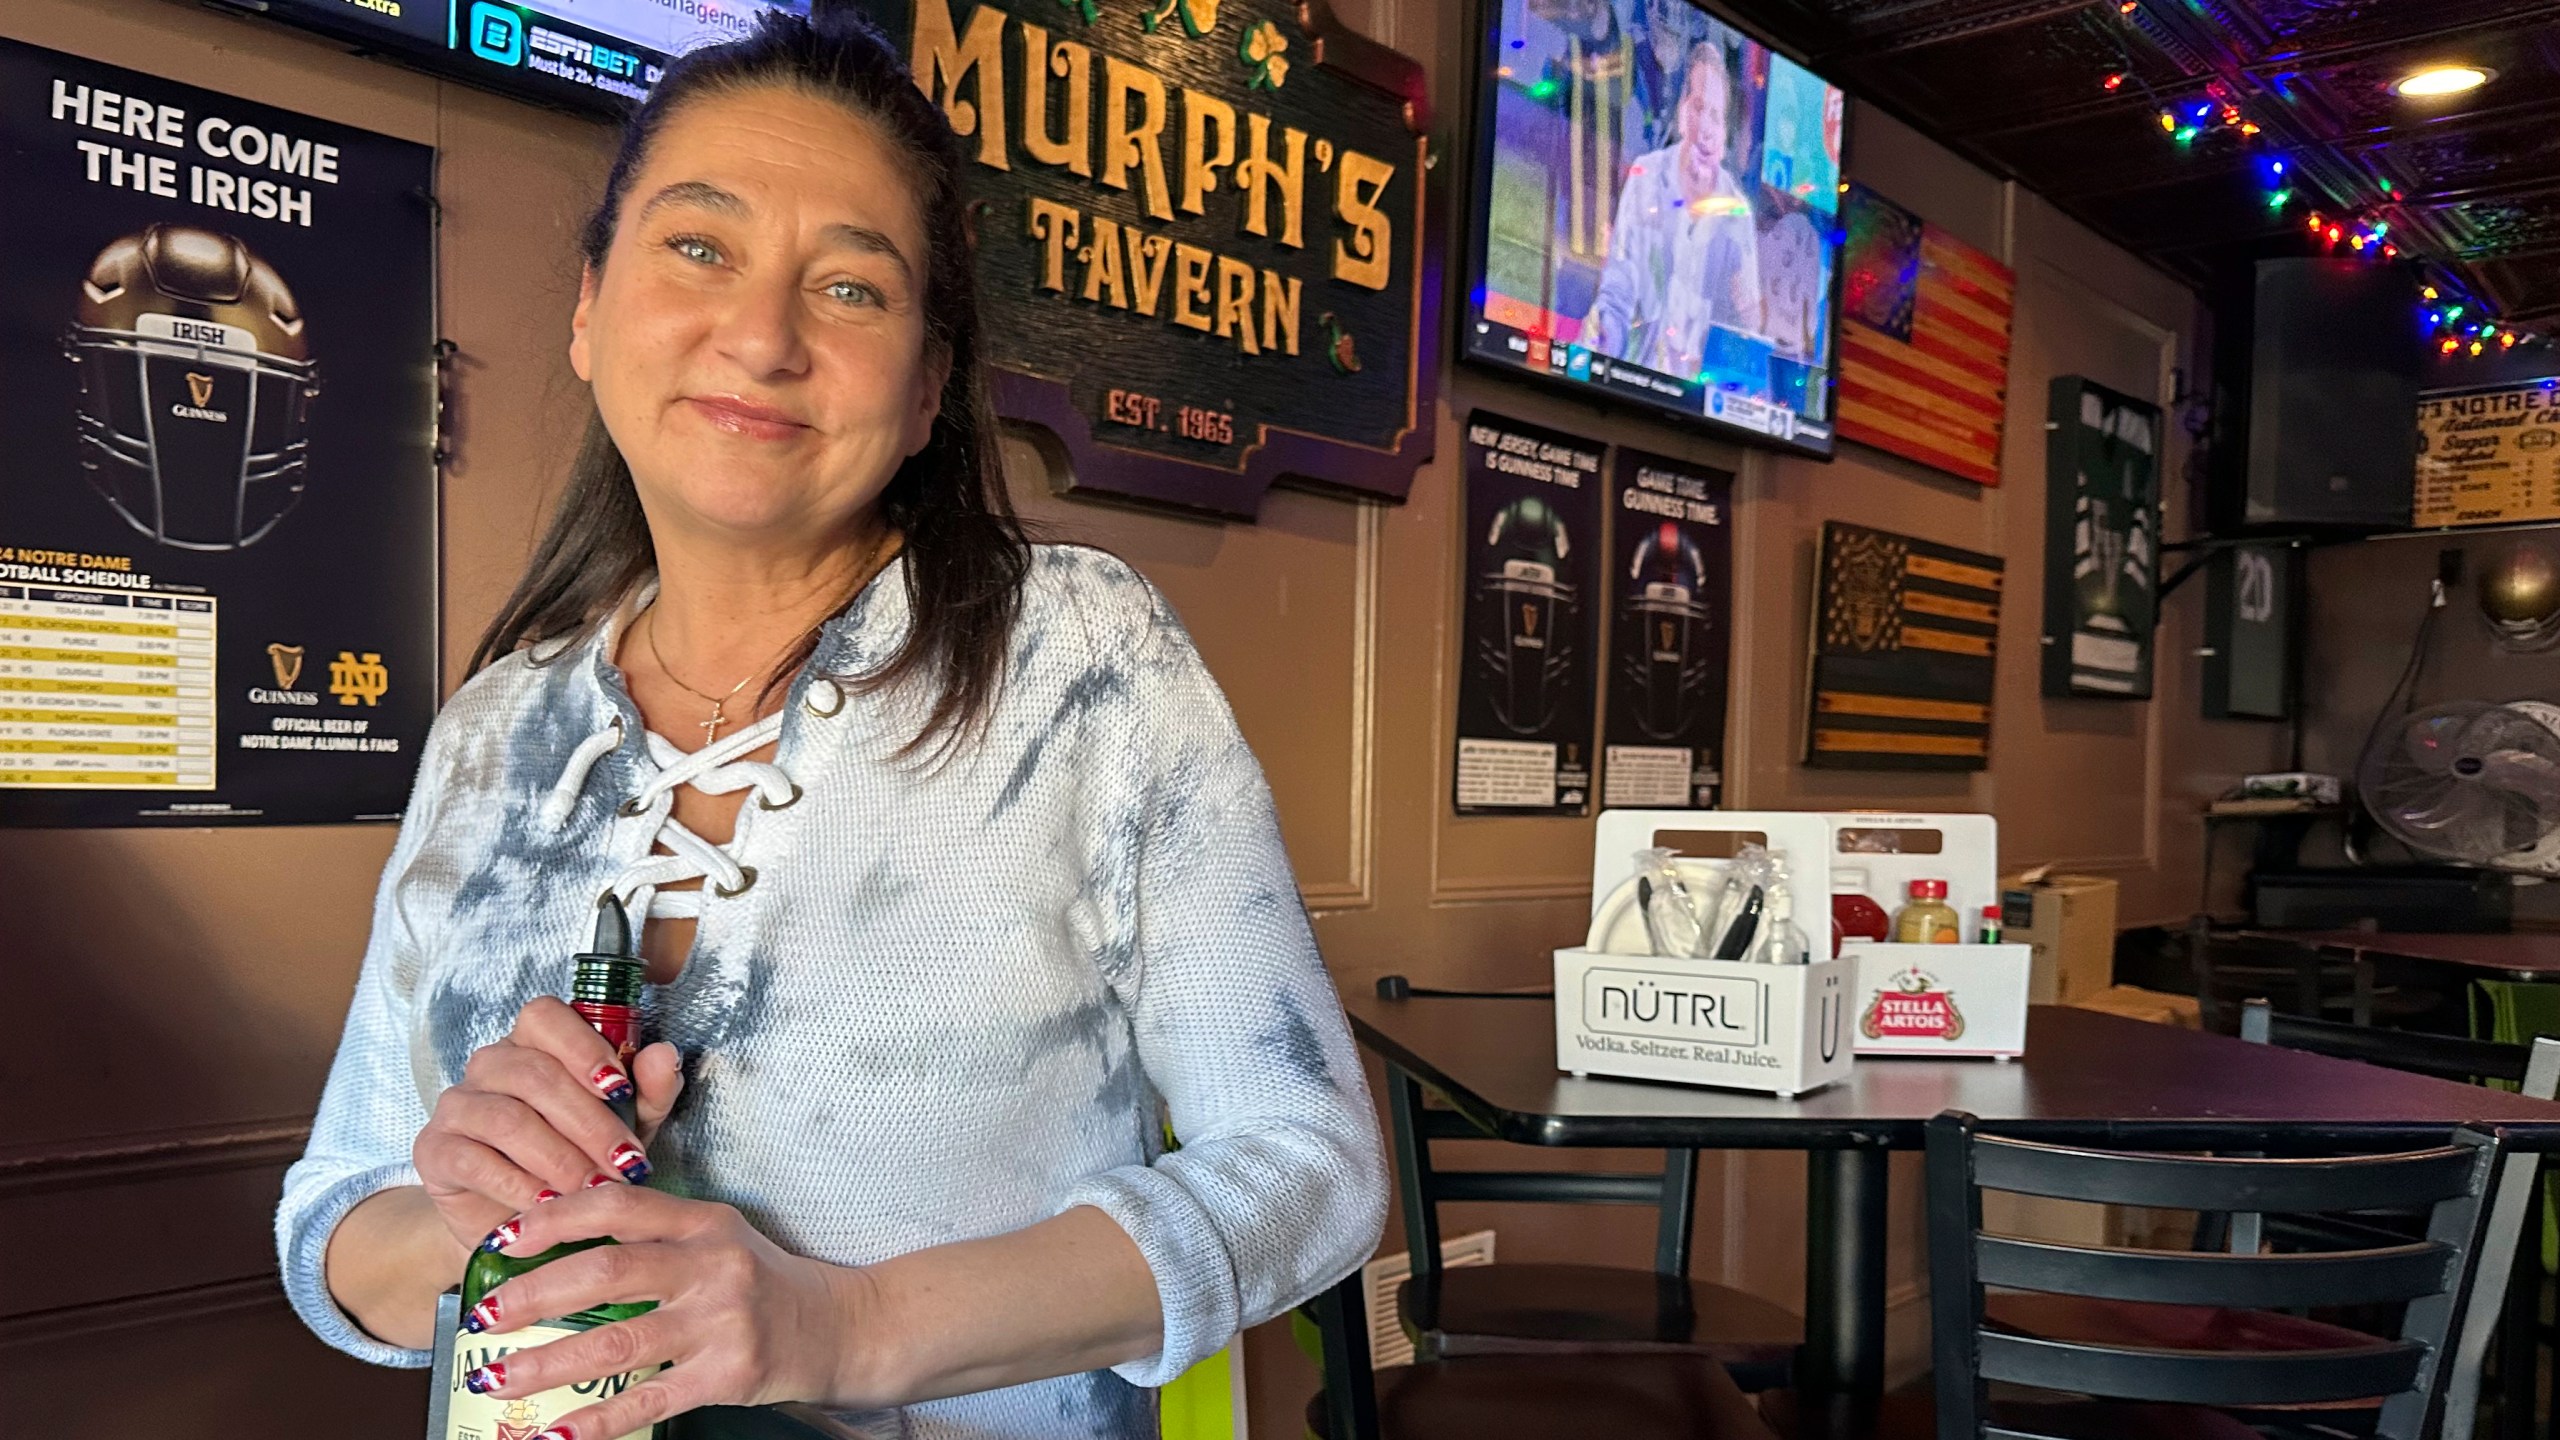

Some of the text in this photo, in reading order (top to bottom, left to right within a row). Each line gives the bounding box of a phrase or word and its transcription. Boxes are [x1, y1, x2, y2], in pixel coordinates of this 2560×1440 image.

[655, 0, 751, 34] anageme
[52, 79, 339, 184] HERE COME
[909, 0, 1395, 291] MURPH'S
[77, 140, 312, 227] THE IRISH
[1031, 198, 1303, 355] TAVERN
[172, 322, 225, 345] IRISH
[171, 404, 228, 423] GUINNESS
[2451, 391, 2541, 416] NOTRE
[1108, 389, 1233, 445] EST. 1965
[1470, 424, 1500, 448] NEW
[1498, 453, 1554, 482] GUINNESS
[1623, 487, 1686, 519] GUINNESS
[17, 549, 78, 567] NOTRE
[79, 554, 132, 571] DAME
[62, 569, 151, 589] SCHEDULE
[249, 687, 319, 706] GUINNESS
[272, 717, 369, 734] OFFICIAL BEER OF
[240, 734, 399, 753] NOTRE DAME ALUMNI & FANS
[1881, 1000, 1946, 1014] STELLA
[1820, 976, 1841, 1064] Ü
[1880, 1014, 1946, 1029] ARTOIS
[1576, 1034, 1630, 1054] Vodka.
[1693, 1046, 1730, 1063] Real
[1731, 1049, 1782, 1069] Juice.
